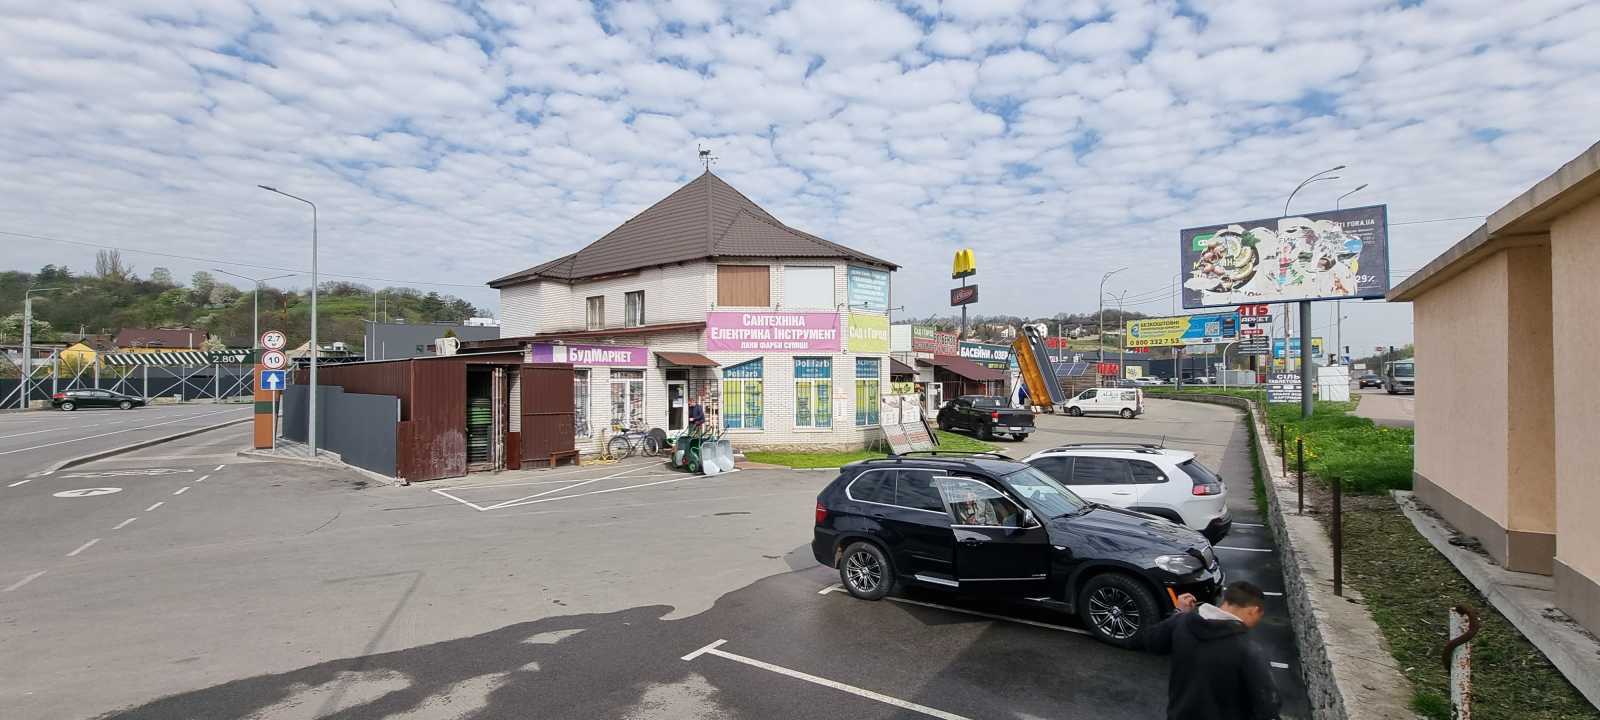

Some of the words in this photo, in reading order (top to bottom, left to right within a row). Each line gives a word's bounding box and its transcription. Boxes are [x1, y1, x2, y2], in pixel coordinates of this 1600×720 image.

[960, 345, 991, 359] БАСЕЙНИ
[212, 355, 235, 363] 2.80
[269, 356, 280, 364] 10
